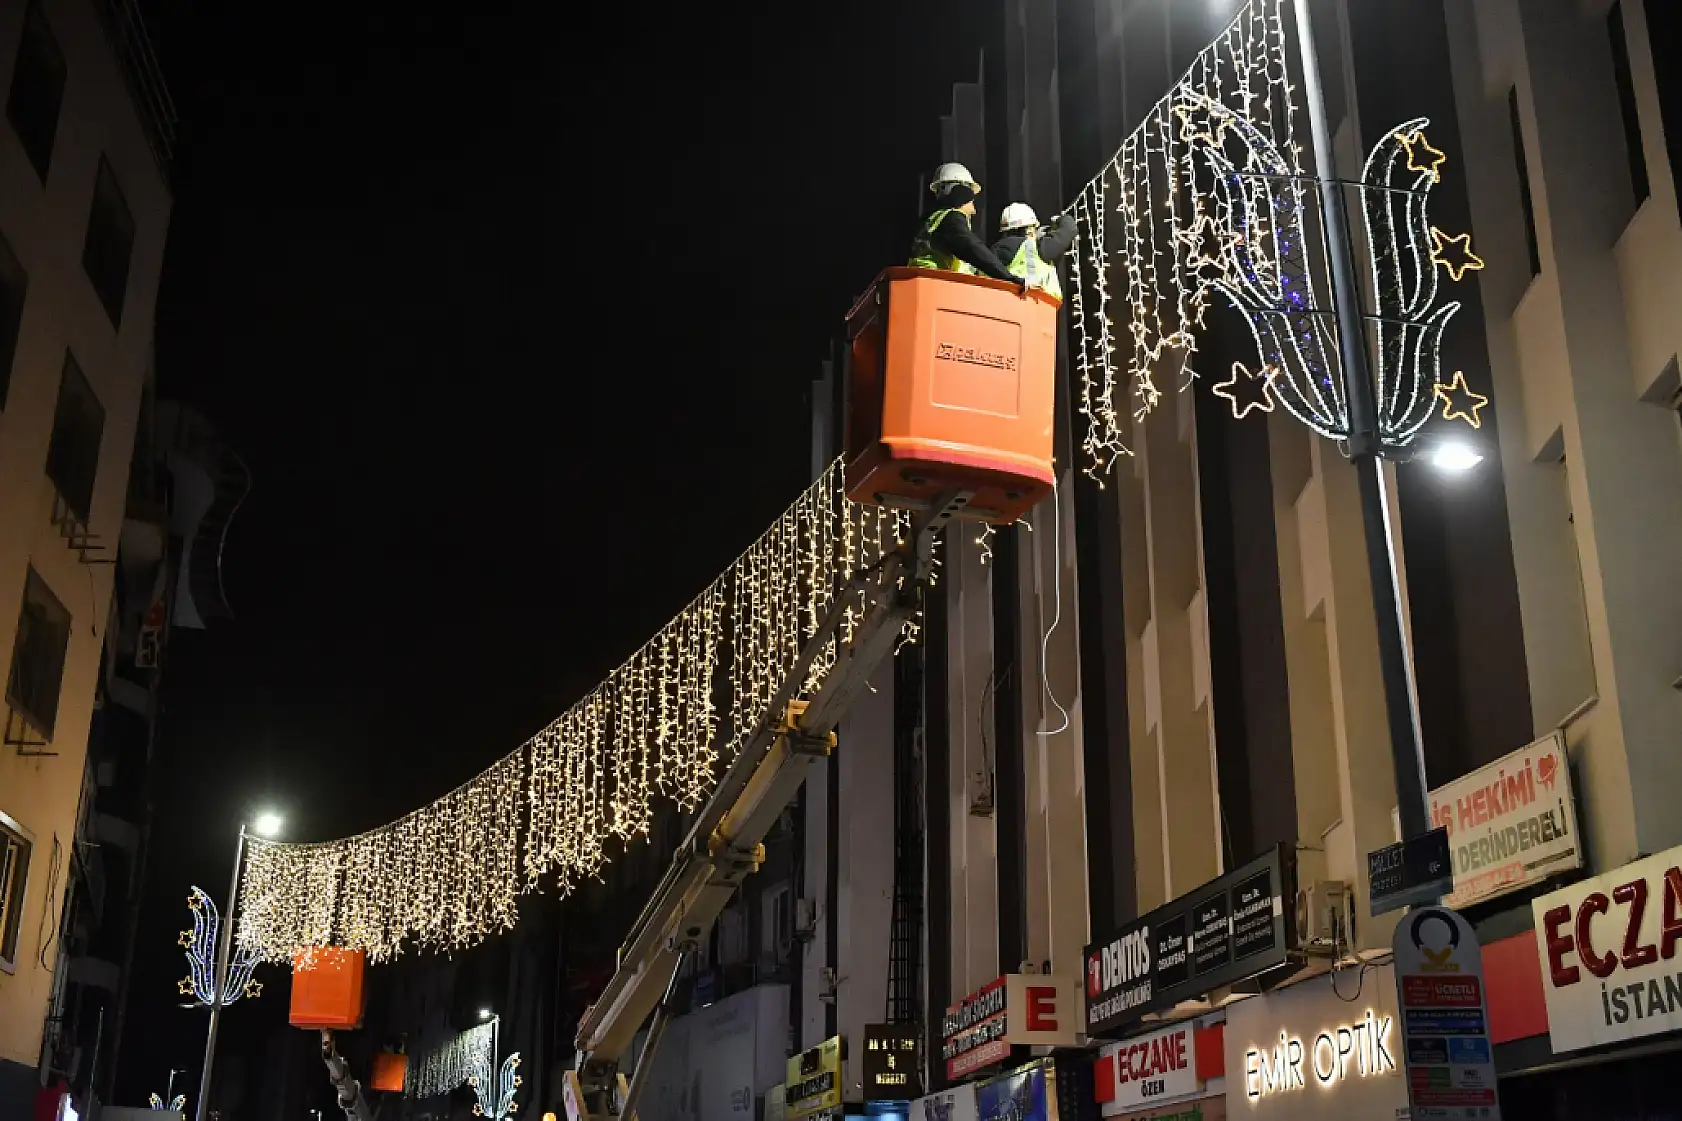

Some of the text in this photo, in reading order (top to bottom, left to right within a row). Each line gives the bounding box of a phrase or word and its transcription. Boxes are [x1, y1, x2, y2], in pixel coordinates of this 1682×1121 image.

[1457, 758, 1536, 833] HEKİMİ
[1457, 797, 1568, 874] DERİNDERELİ
[1102, 925, 1150, 993] DENTOS
[1543, 864, 1682, 988] ECZA
[1025, 986, 1058, 1032] E
[1601, 970, 1682, 1027] İSTAN
[1117, 1030, 1188, 1085] ECZANE
[1246, 1010, 1395, 1098] EMİR OPTİK
[1140, 1079, 1165, 1098] ÖZEN
